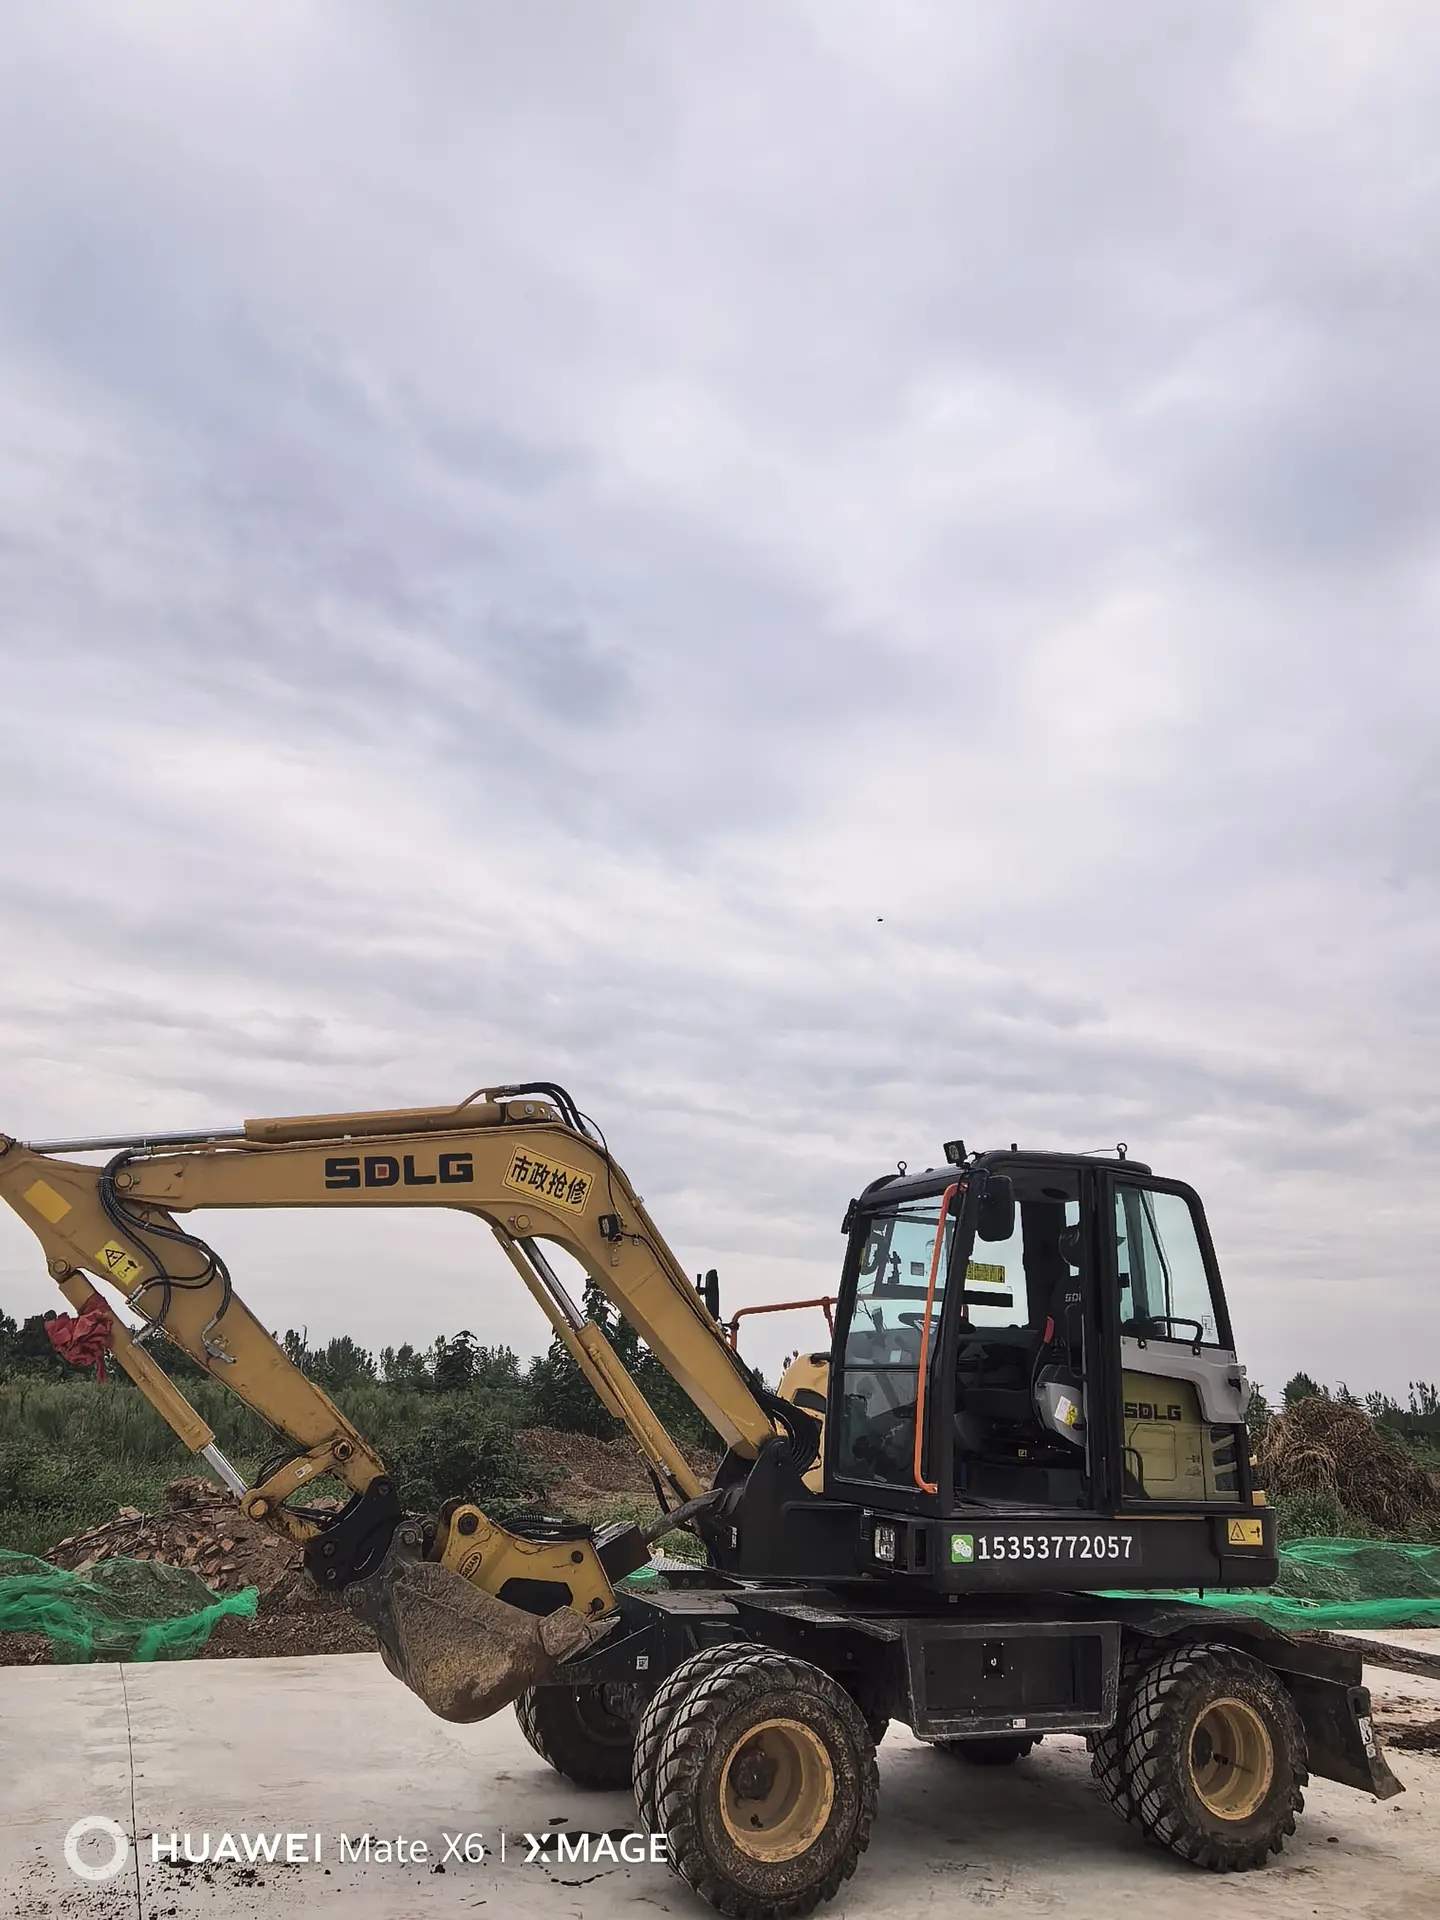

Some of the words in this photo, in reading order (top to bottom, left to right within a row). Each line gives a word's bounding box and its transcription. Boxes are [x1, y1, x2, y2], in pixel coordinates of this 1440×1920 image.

[325, 1153, 474, 1189] SDLG
[511, 1155, 588, 1205] 市政抢修
[1124, 1402, 1182, 1421] SDLG
[978, 1536, 1133, 1560] 15353772057
